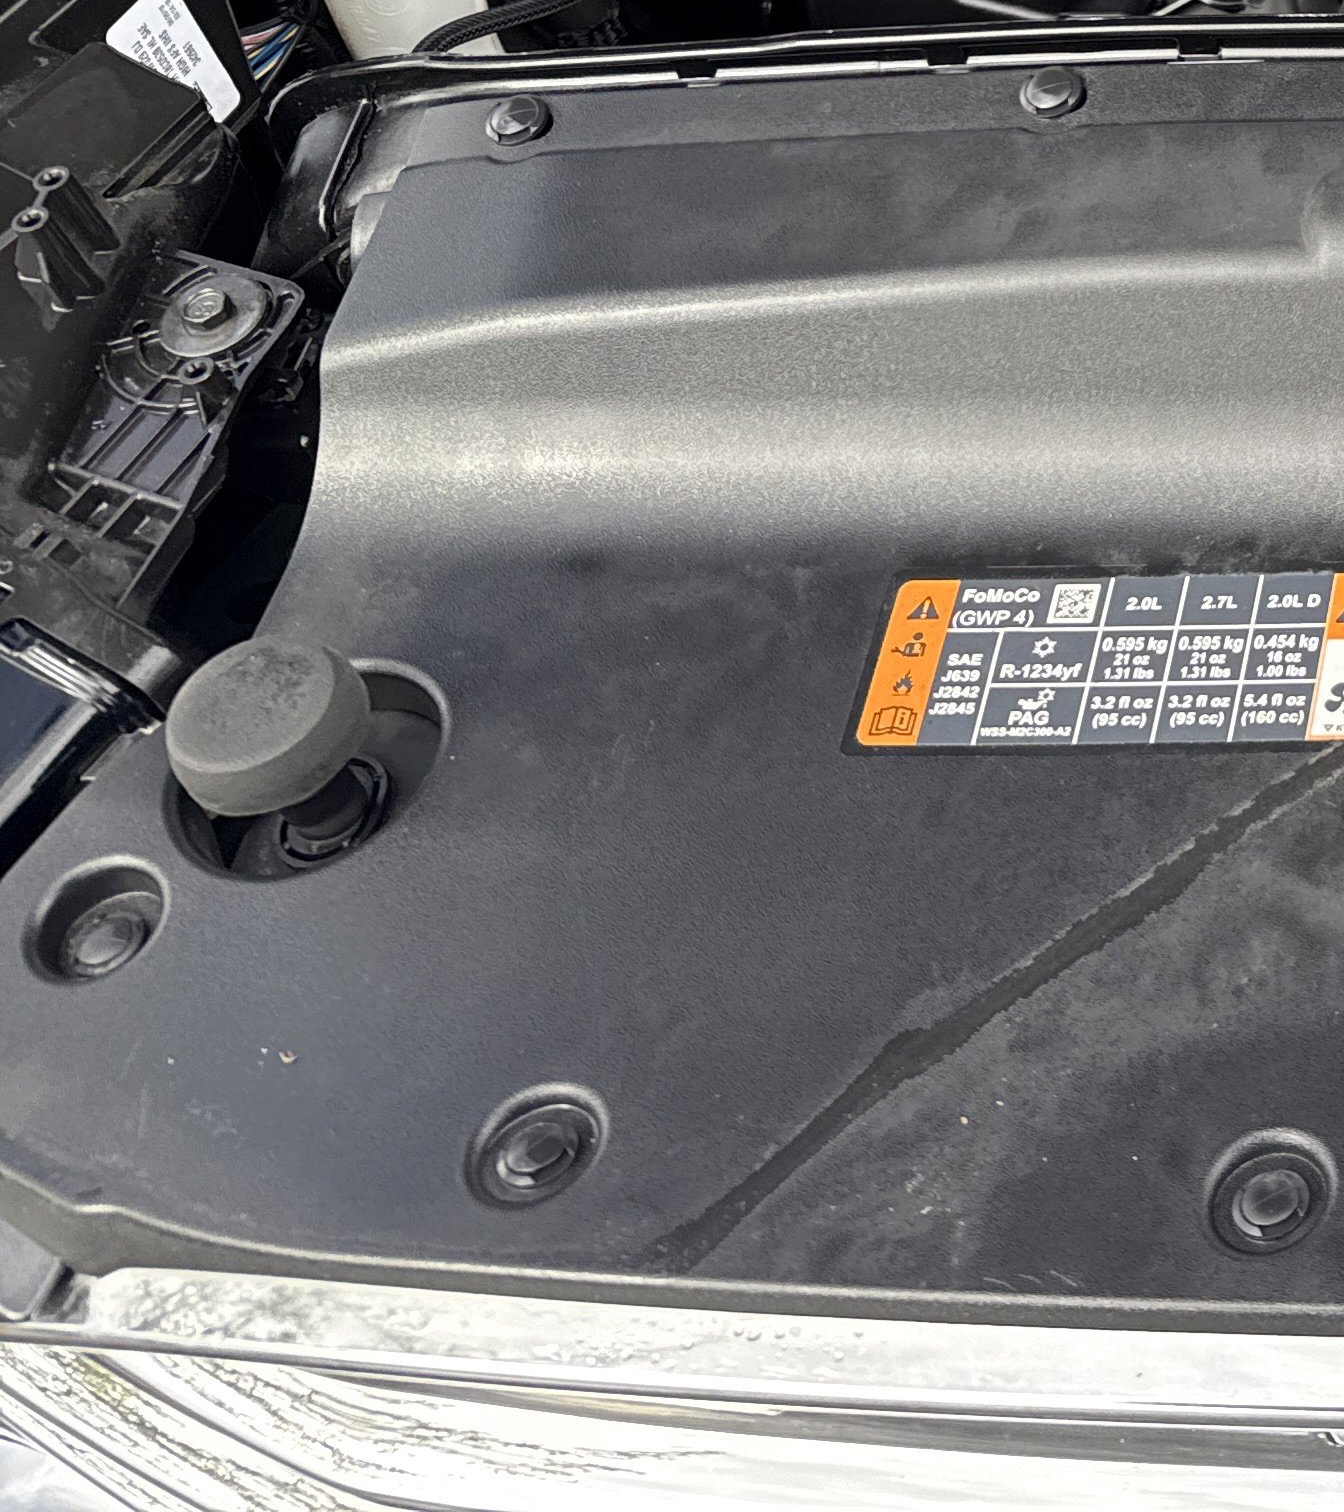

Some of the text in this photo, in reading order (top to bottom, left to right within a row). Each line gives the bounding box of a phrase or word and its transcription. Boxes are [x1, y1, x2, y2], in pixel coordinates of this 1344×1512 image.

[962, 588, 1041, 604] FoMoCo
[1201, 595, 1238, 610] 2.7L
[1267, 594, 1321, 608] 2.0L D
[1125, 597, 1162, 611] 2.0L
[952, 610, 1035, 628] (GWP 4)
[1102, 637, 1168, 654] 0.595 kg
[1178, 635, 1244, 653] 0.595 kg
[1253, 634, 1319, 652] 0.454 kg
[947, 653, 983, 666] SAE
[1113, 653, 1150, 666] 21 oz
[1189, 652, 1226, 665] 21 oz
[1267, 651, 1302, 663] 16 oz
[941, 669, 980, 682] J639
[999, 663, 1083, 681] R-1234yf
[1104, 667, 1154, 680] 1.31 lbs
[1180, 666, 1231, 678] 1.31 lbs
[1256, 665, 1307, 677] 1.00 lbs
[933, 686, 980, 699] J2842
[1090, 695, 1154, 710] 3.2 fl oz
[1168, 694, 1231, 708] 3.2 fl oz
[1243, 693, 1307, 708] 5.4 fl oz
[928, 702, 976, 715] J2845
[1007, 710, 1050, 725] PAG
[1092, 713, 1148, 729] (95 cc)
[1170, 711, 1225, 728] (95 cc)
[1241, 710, 1305, 727] (160 cc)
